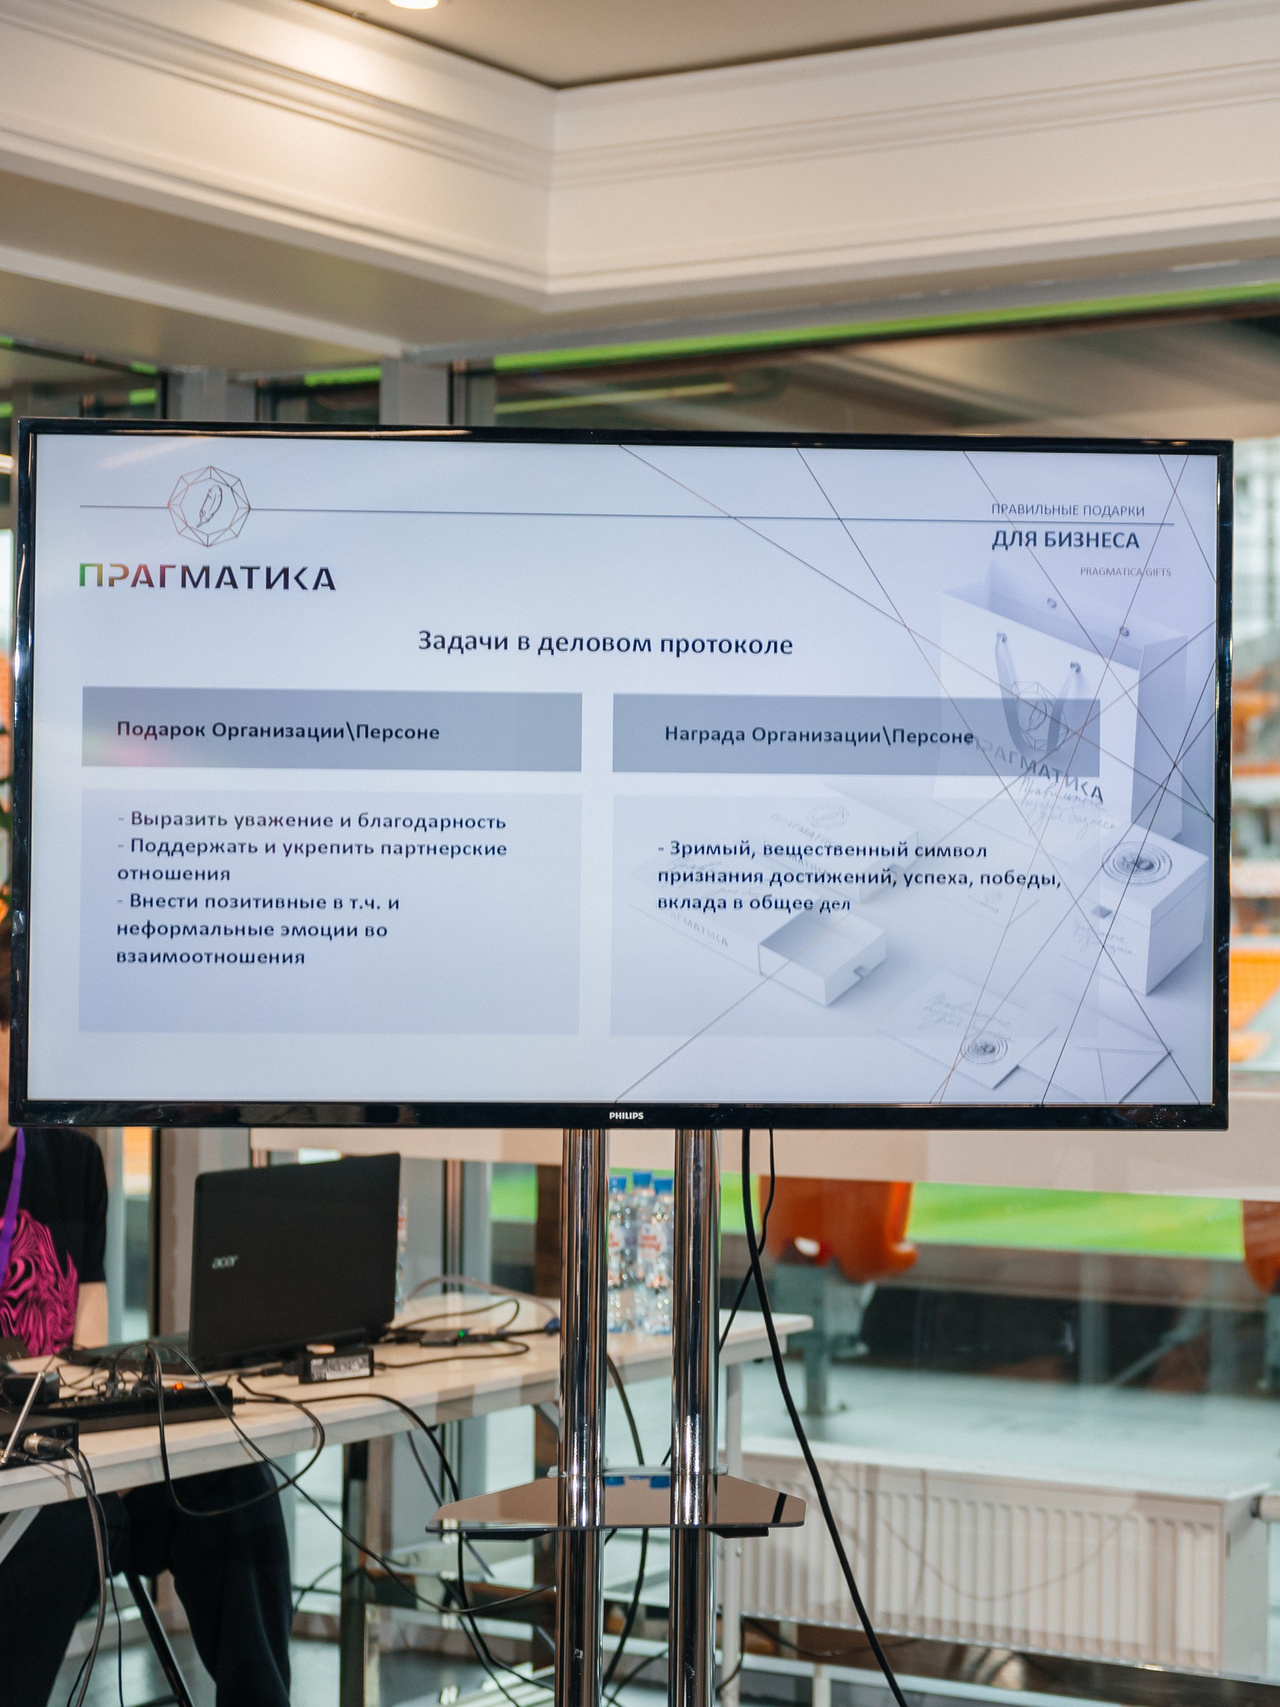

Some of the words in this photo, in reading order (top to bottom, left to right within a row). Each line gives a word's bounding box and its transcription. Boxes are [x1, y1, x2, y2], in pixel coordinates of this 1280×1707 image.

[991, 502, 1079, 516] ПРАВИЛЬНЫЕ
[1083, 504, 1145, 519] ПОДАРКИ
[991, 530, 1037, 551] ДЛЯ
[1044, 531, 1140, 549] БИЗНЕСА
[79, 562, 336, 591] ПРАГМАТИКА
[418, 630, 508, 655] Задачи
[517, 635, 531, 651] в
[537, 636, 652, 656] деловом
[660, 638, 793, 658] протоколе
[117, 720, 206, 741] Подарок
[211, 721, 440, 743] Организации\Персоне
[665, 725, 745, 746] Награда
[751, 725, 974, 747] Организации\Персоне
[131, 810, 228, 830] Выразить
[234, 815, 334, 830] уважение
[340, 816, 351, 828] и
[357, 812, 507, 833] благодарность
[130, 837, 258, 857] Поддержать
[264, 842, 276, 854] и
[282, 843, 375, 858] укрепить
[381, 844, 507, 859] партнерские
[670, 840, 756, 859] Зримый,
[763, 841, 908, 861] вещественный
[914, 846, 987, 858] символ
[117, 868, 230, 881] отношения
[658, 871, 763, 886] признания
[769, 867, 897, 888] достижений,
[903, 872, 974, 888] успеха,
[980, 870, 1061, 890] победы,
[130, 893, 198, 908] Внести
[205, 897, 327, 909] позитивные
[333, 898, 344, 909] в
[349, 898, 381, 910] т.ч.
[388, 899, 399, 910] и
[658, 898, 727, 914] вклада
[733, 899, 743, 909] в
[749, 894, 814, 914] общее
[819, 900, 851, 914] дел
[117, 919, 275, 940] неформальные
[280, 925, 358, 941] эмоции
[364, 926, 388, 937] во
[116, 951, 305, 964] взаимоотношения
[609, 1112, 644, 1120] PHILIPS
[212, 1254, 239, 1270] acer
